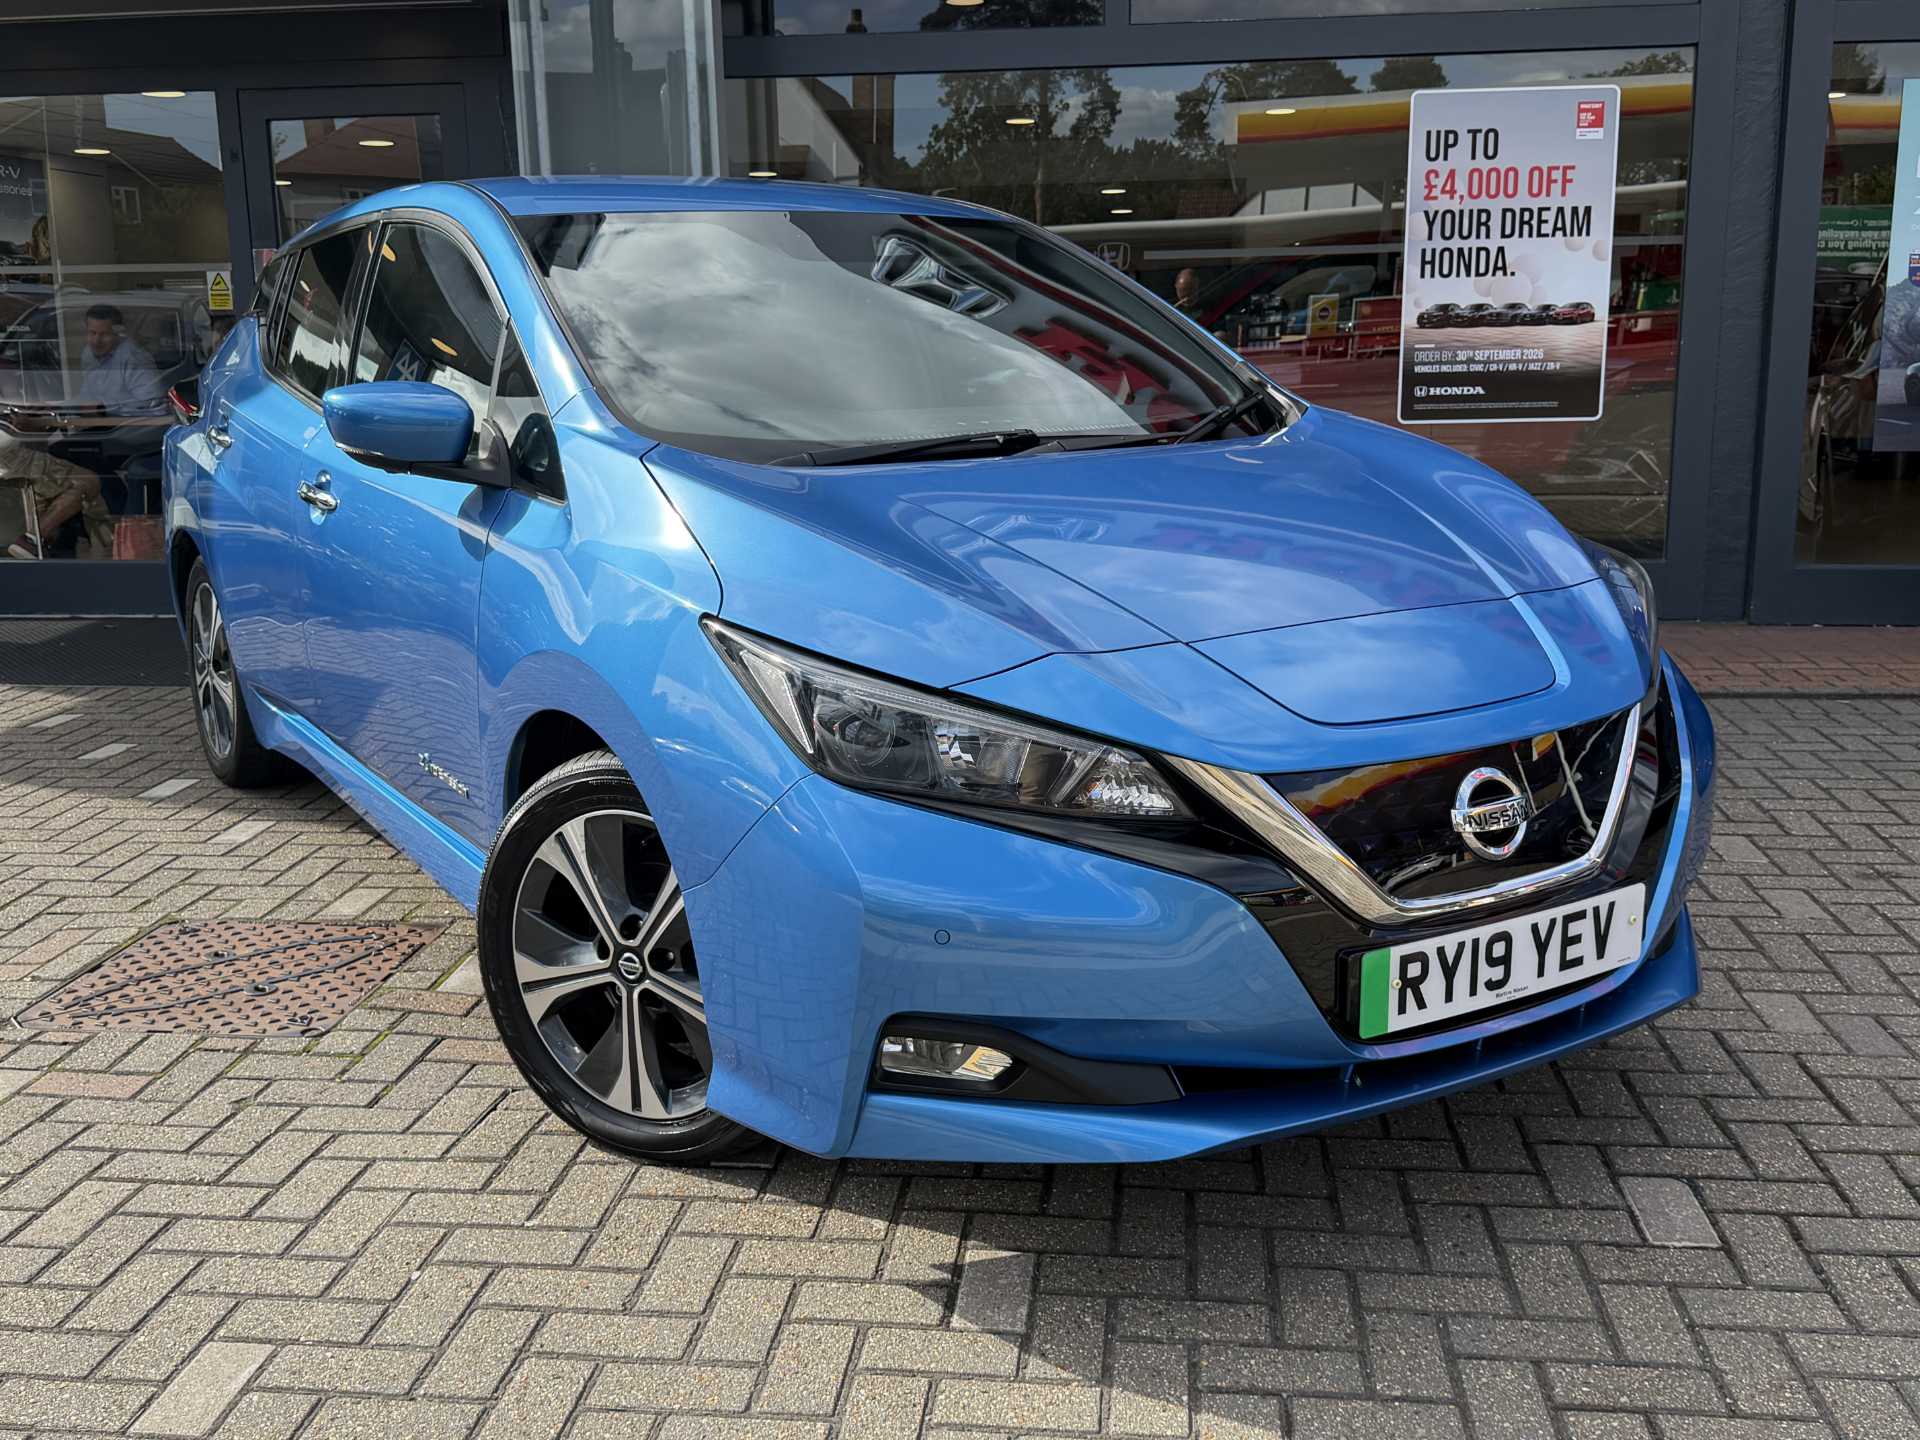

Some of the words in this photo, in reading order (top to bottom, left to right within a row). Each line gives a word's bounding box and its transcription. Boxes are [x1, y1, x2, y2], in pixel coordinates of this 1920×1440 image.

[1425, 129, 1459, 162] UP
[1467, 128, 1499, 161] TO
[1423, 166, 1519, 205] £4,000
[1527, 165, 1576, 198] OFF
[1423, 207, 1492, 241] YOUR
[1500, 205, 1592, 239] DREAM
[1419, 246, 1516, 279] HONDA.
[1414, 351, 1440, 362] ORDER
[1474, 349, 1521, 361] SEPTEMBER
[1429, 386, 1486, 396] HONDA
[1467, 803, 1529, 828] NISSAN
[1397, 930, 1513, 1016] RY19
[1530, 901, 1616, 978] YEV
